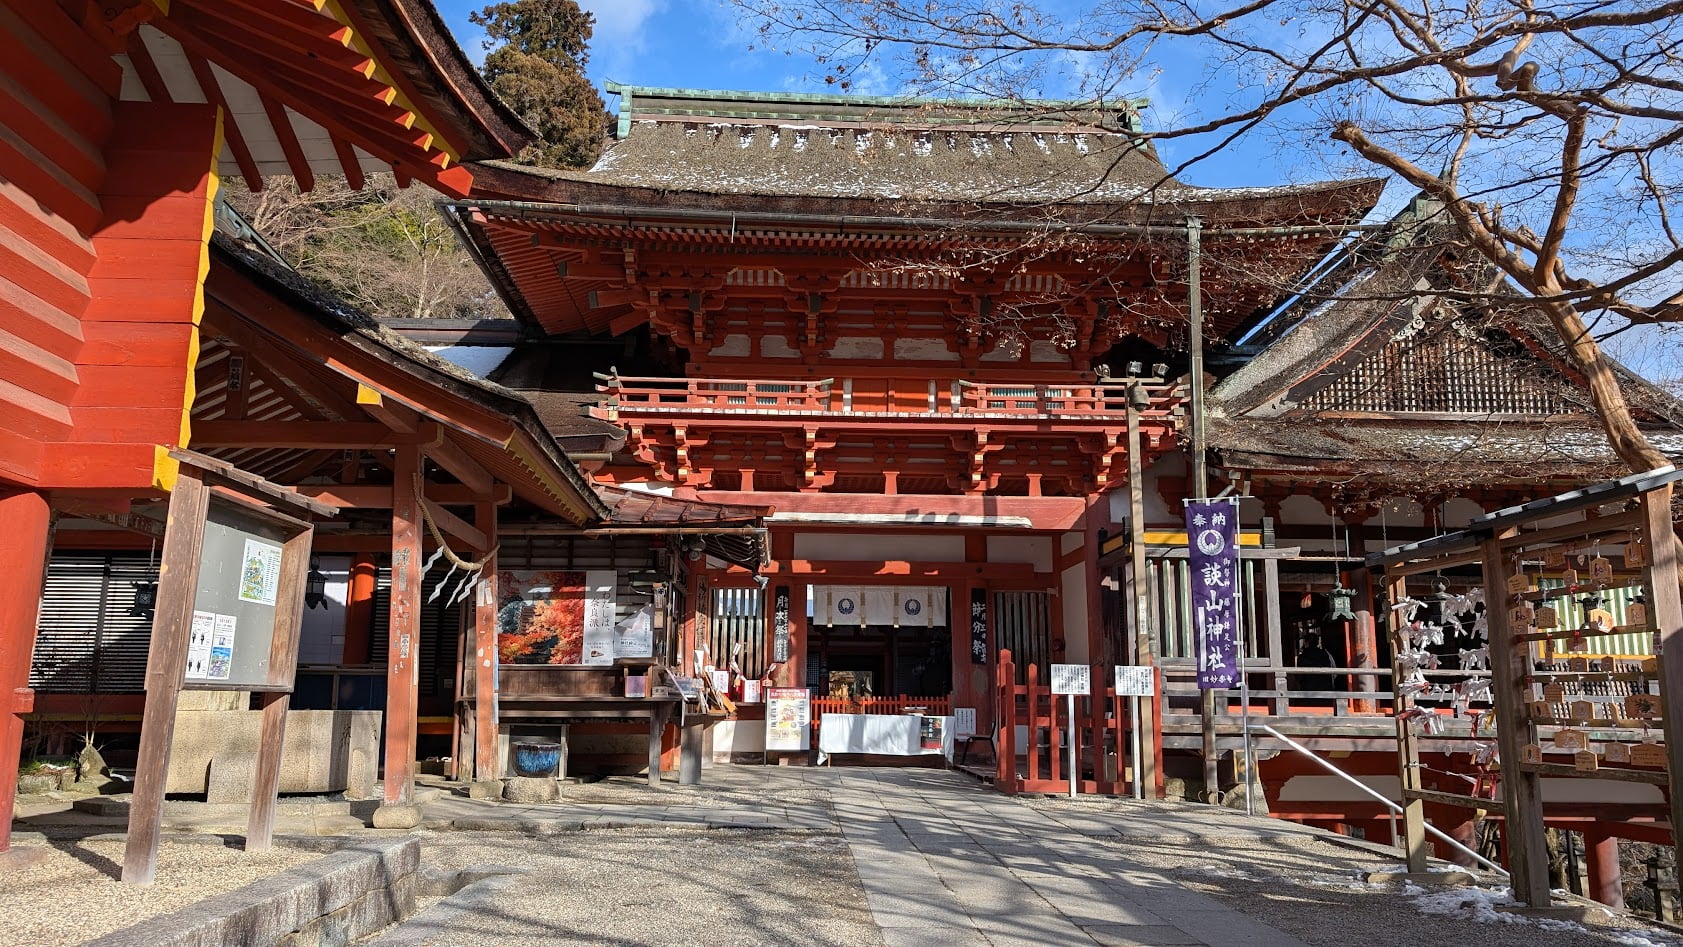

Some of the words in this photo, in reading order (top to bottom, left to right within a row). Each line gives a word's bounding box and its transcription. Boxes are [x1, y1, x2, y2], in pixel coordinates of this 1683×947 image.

[1193, 512, 1226, 527] 奉納
[1201, 562, 1227, 671] 談山神社
